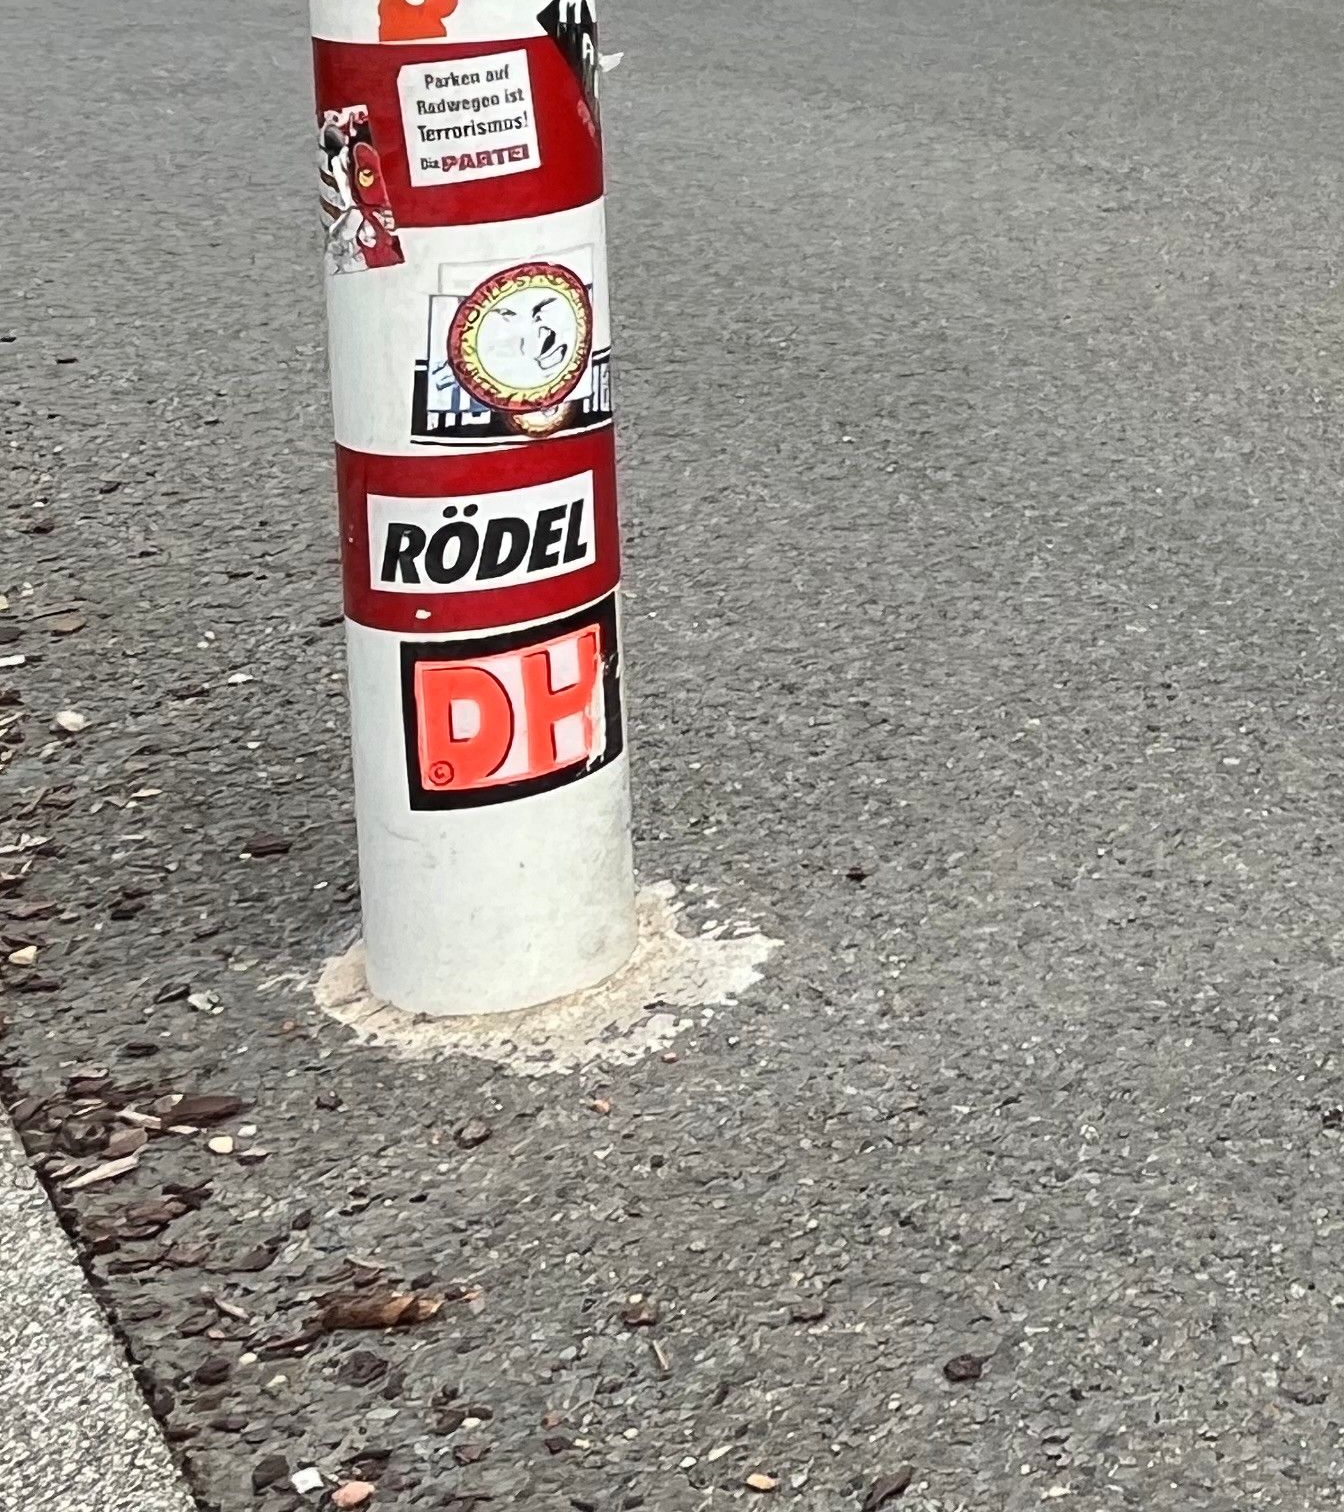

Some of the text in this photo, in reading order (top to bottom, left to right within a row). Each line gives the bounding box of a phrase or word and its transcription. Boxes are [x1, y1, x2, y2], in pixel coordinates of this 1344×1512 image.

[424, 64, 509, 89] Parken auf
[504, 88, 525, 104] ist
[417, 110, 528, 143] Terrorismus!
[380, 498, 588, 584] RÖDEL
